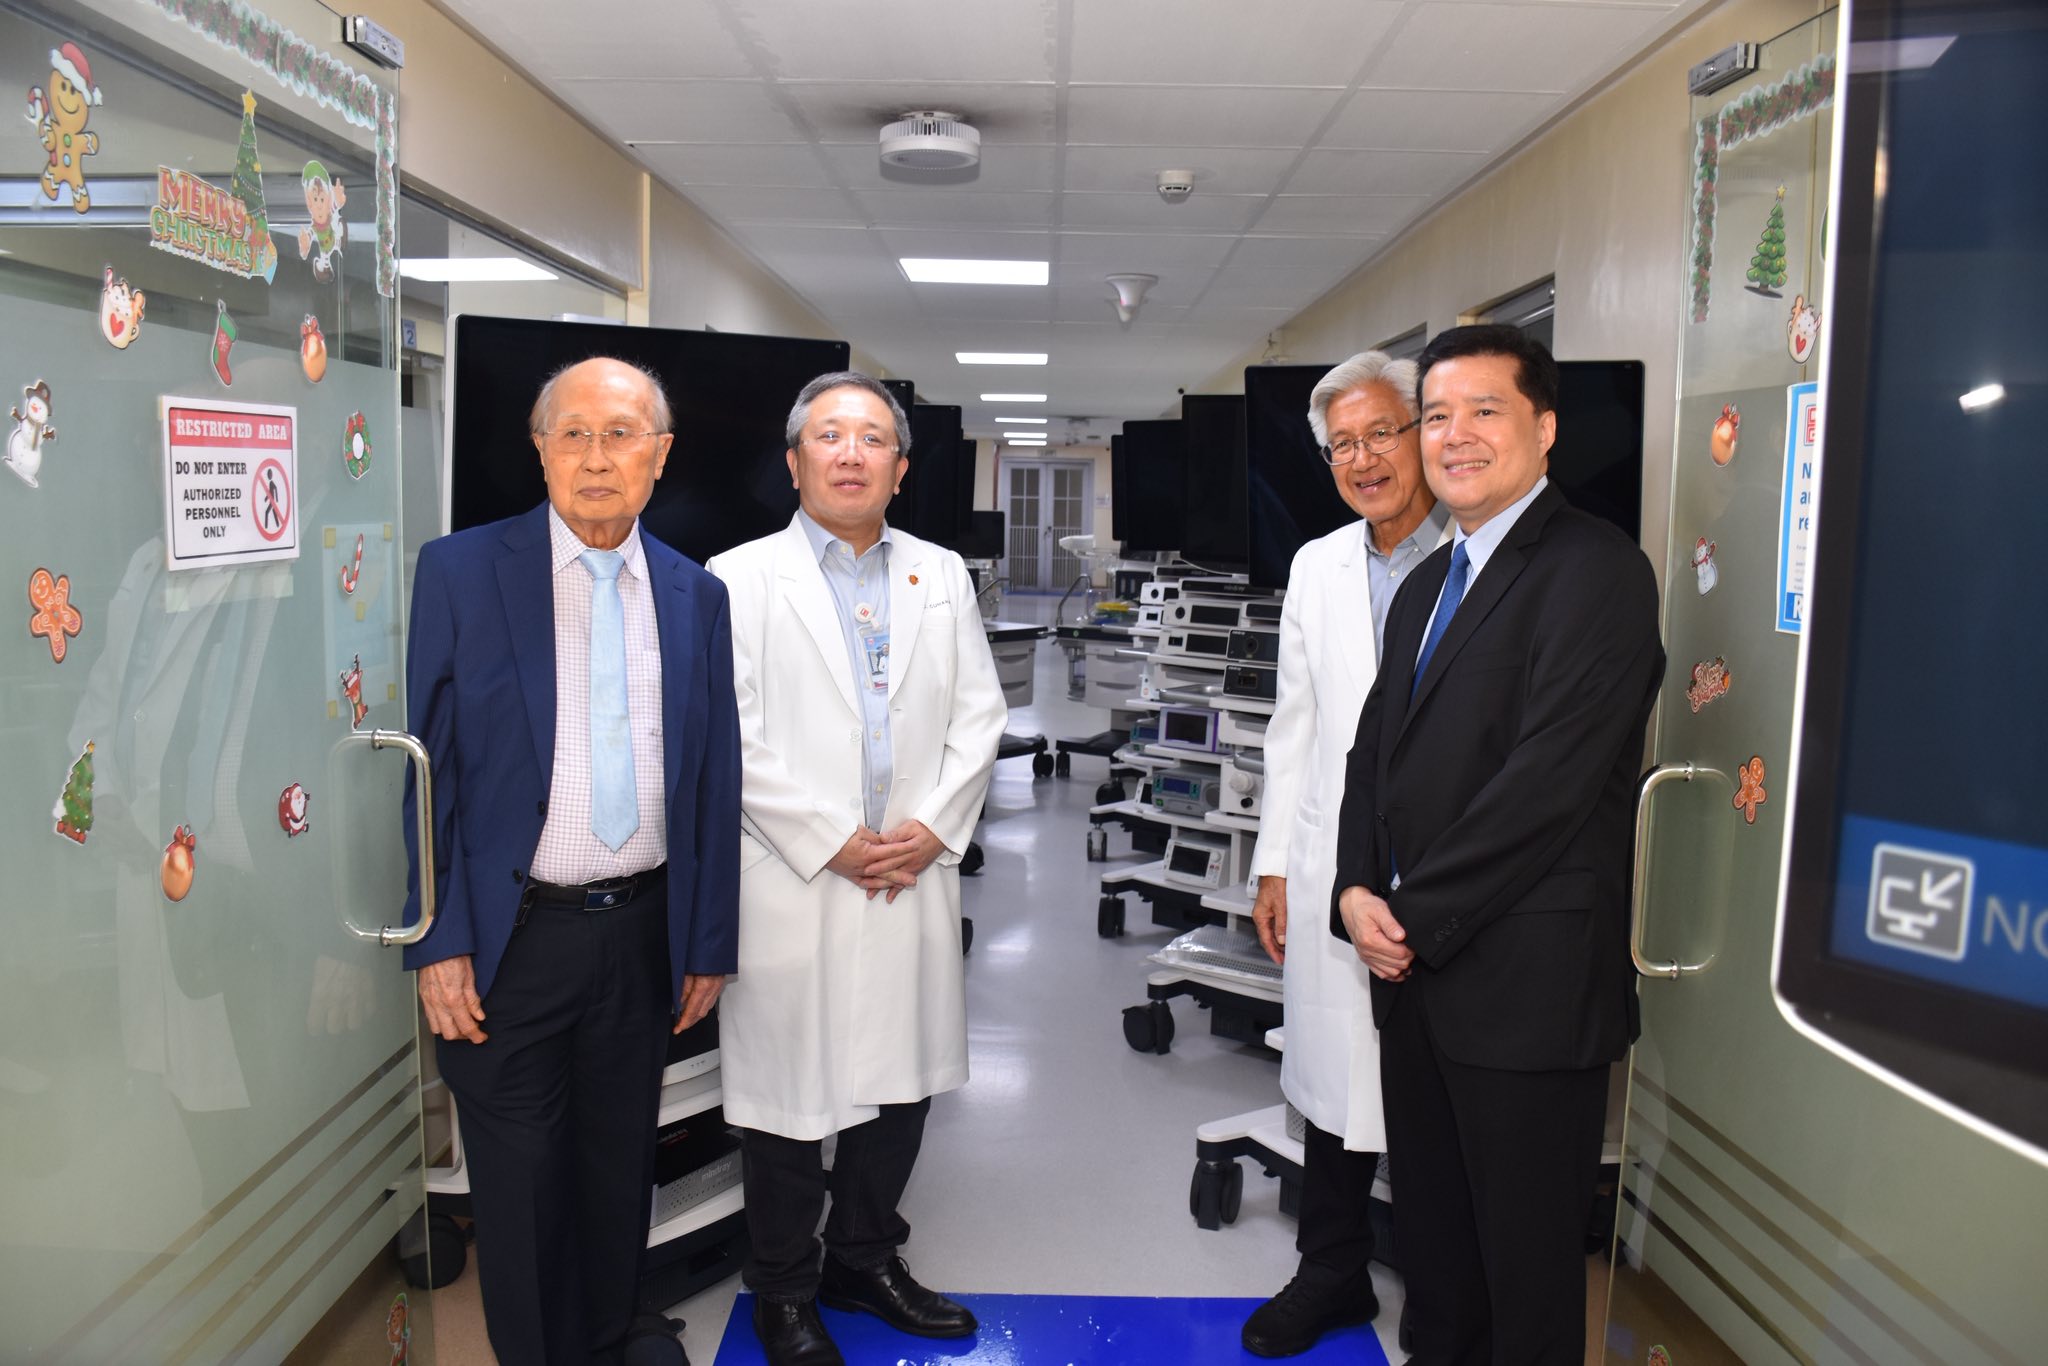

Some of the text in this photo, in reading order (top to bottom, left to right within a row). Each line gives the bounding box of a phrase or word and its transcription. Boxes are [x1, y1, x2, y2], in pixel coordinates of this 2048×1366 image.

[160, 168, 246, 239] MERRY
[151, 206, 252, 271] CHRISTMAS
[176, 418, 287, 440] RESTRICTED AREA
[176, 461, 247, 475] DO NOT ENTER
[183, 488, 241, 501] AUTHORIZED
[186, 506, 241, 520] PERSONNEL
[203, 525, 226, 538] ONLY
[701, 1160, 732, 1182] mindray
